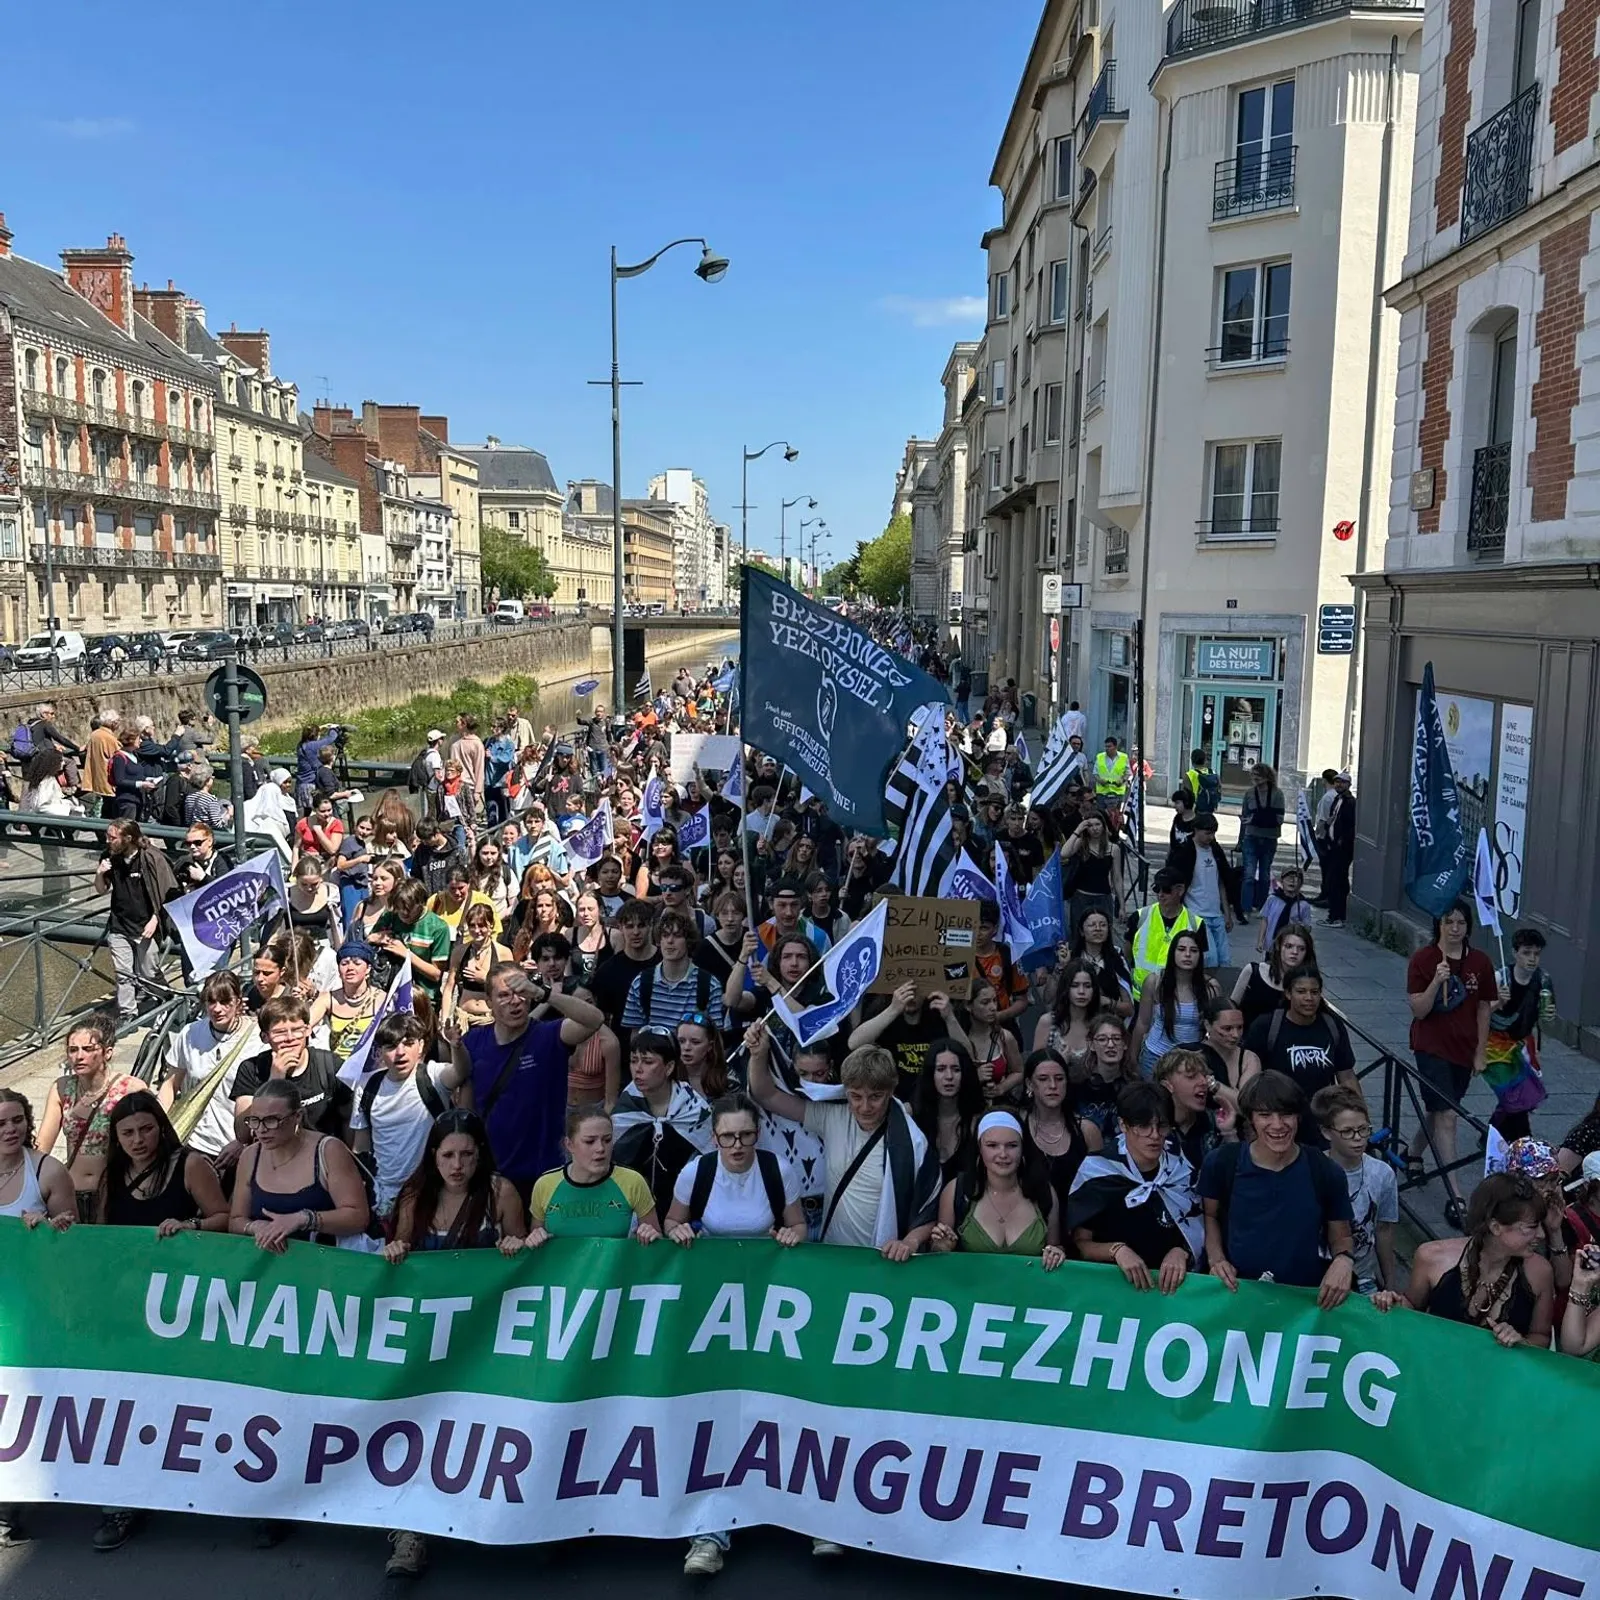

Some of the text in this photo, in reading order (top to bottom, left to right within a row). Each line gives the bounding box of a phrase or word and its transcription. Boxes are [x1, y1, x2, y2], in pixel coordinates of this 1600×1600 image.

[771, 590, 912, 687] BREZHONEG
[1210, 646, 1261, 660] LA NUIT
[1209, 660, 1260, 670] DES TEMPS
[1506, 721, 1518, 732] UNE
[1504, 744, 1525, 757] UNIQUE
[1502, 785, 1516, 795] HAUT
[1501, 795, 1526, 810] DE GAMM
[887, 906, 930, 926] BZH
[145, 1272, 1401, 1427] UNANET EVIT AR BREZHONEG
[304, 1419, 532, 1503] POUR
[556, 1426, 659, 1500] LA
[684, 1419, 1041, 1530] LANGUE
